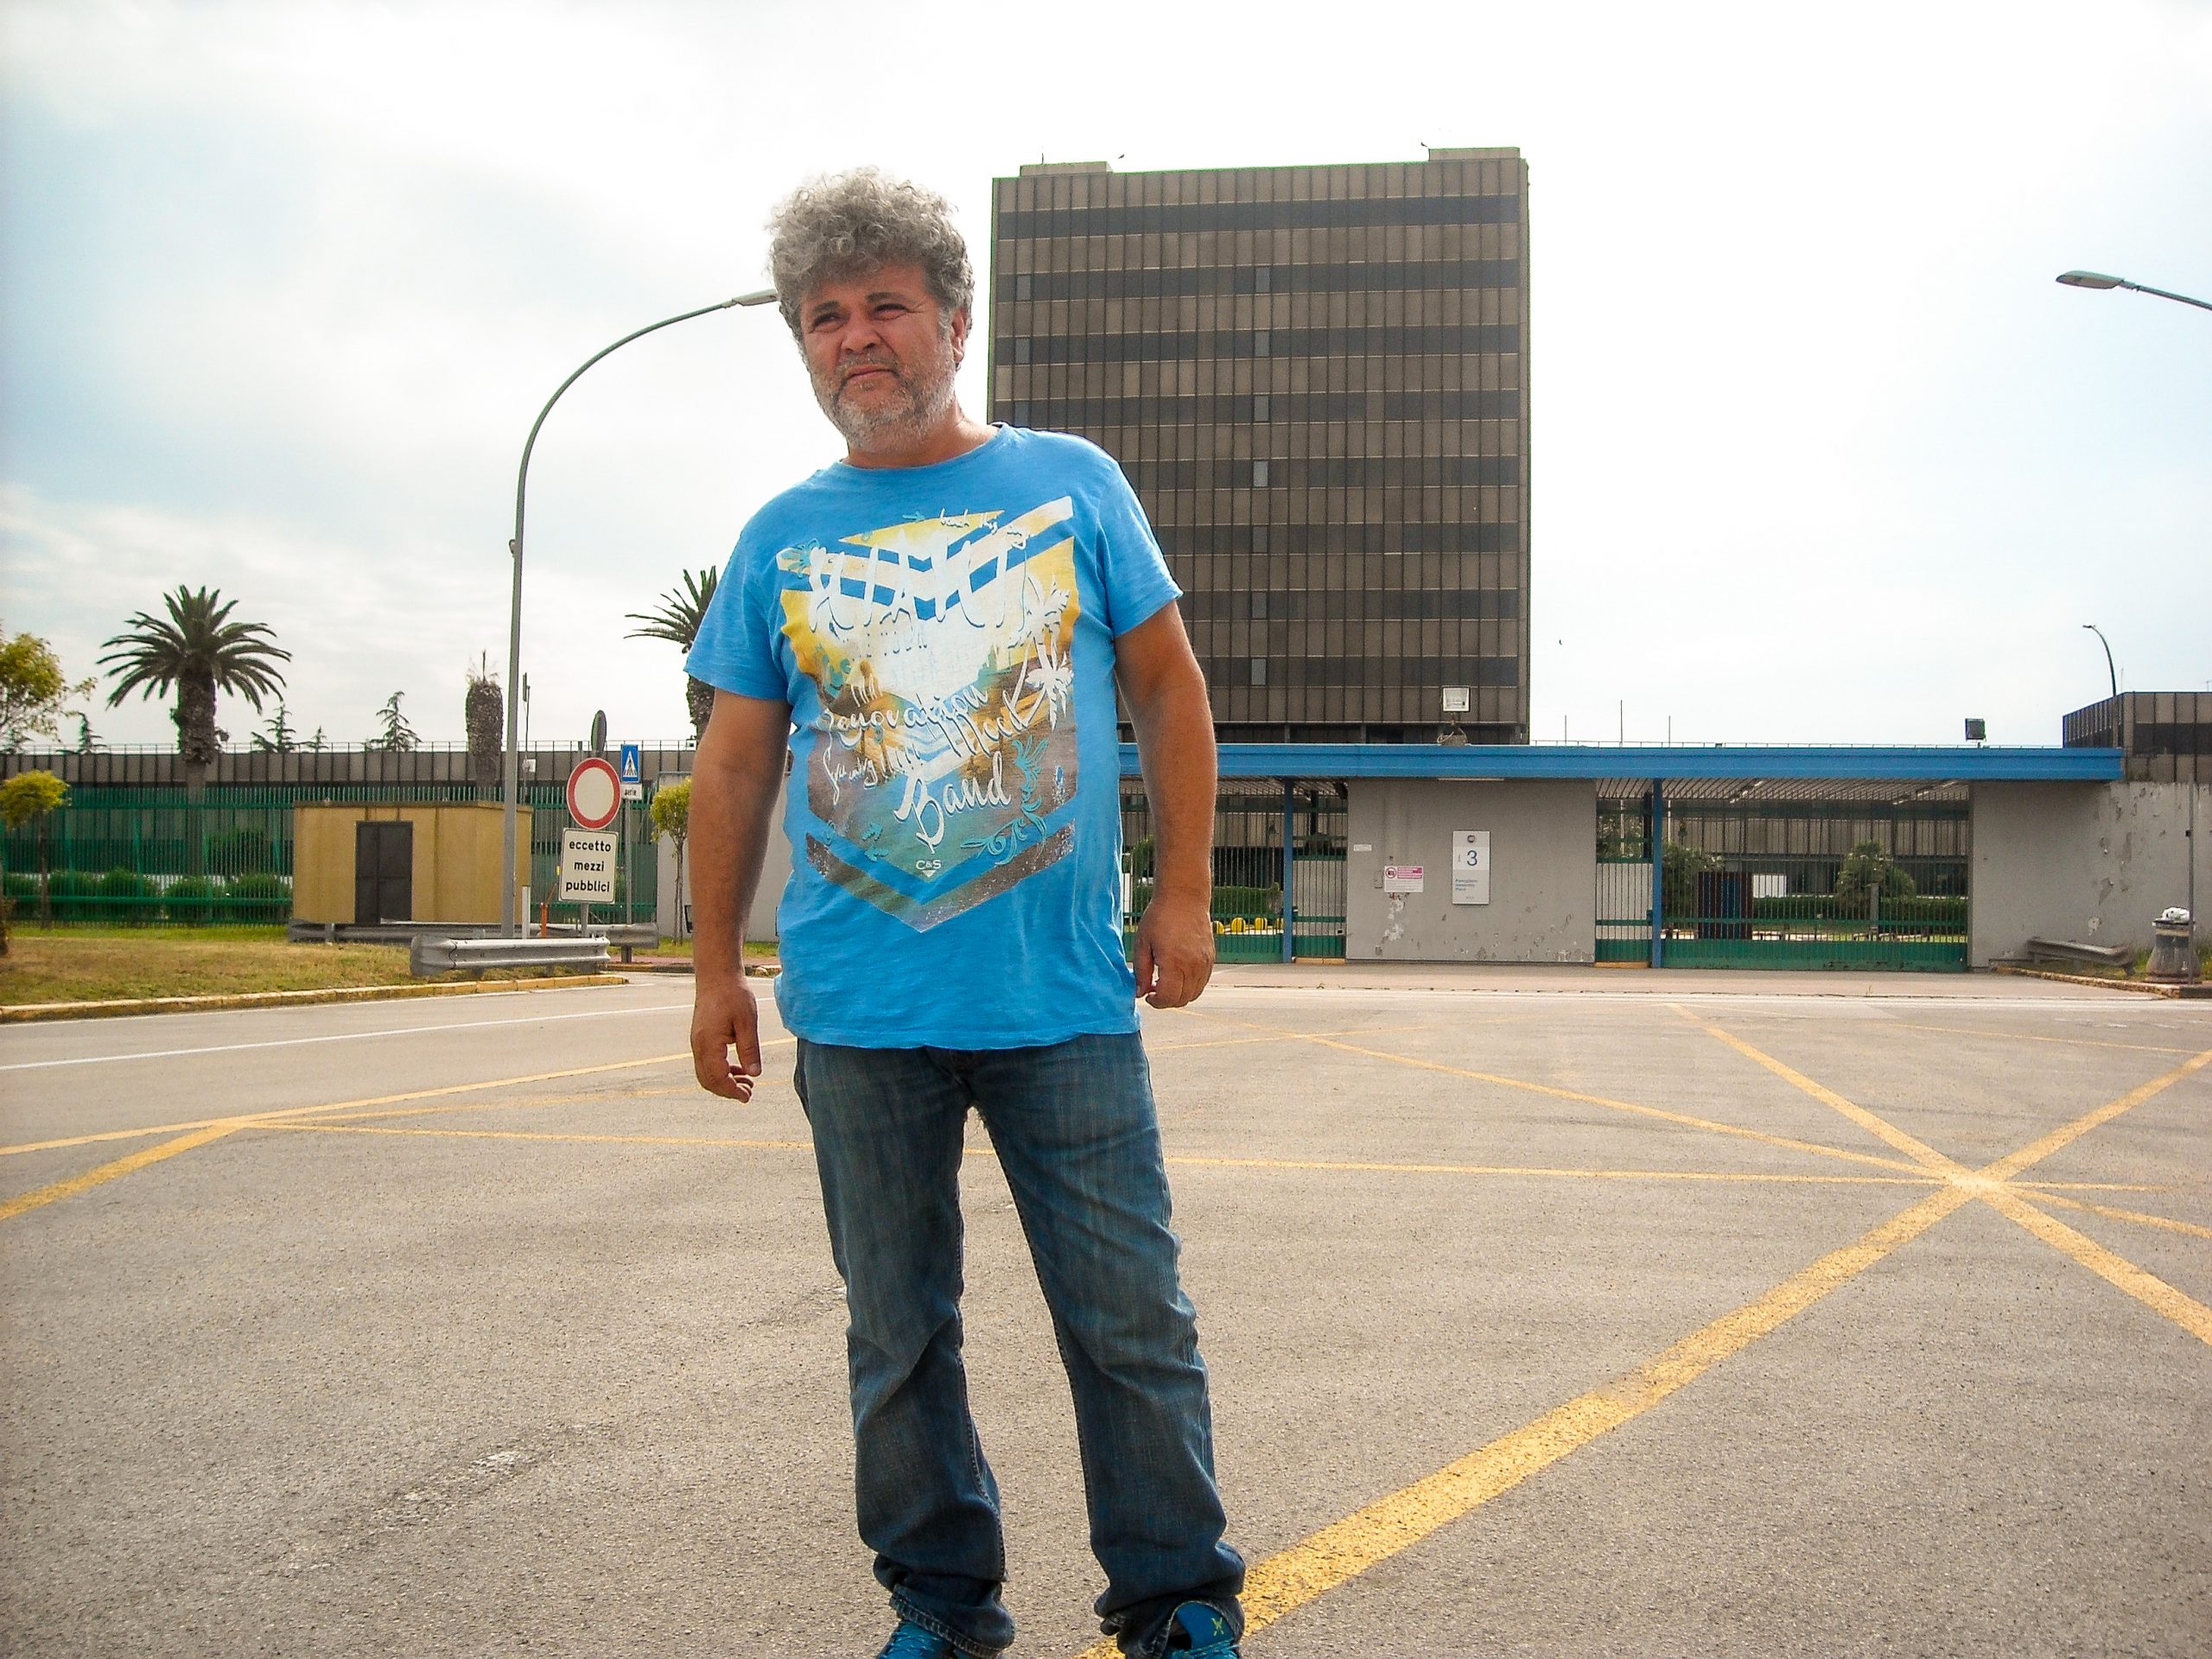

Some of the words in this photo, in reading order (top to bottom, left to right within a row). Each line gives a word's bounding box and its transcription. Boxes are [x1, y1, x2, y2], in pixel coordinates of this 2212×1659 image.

[893, 750, 1012, 854] Band
[569, 840, 612, 852] eccetto
[1466, 850, 1478, 867] 3
[574, 861, 605, 872] mezzi
[915, 859, 942, 871] C&S
[565, 880, 610, 893] pubblici
